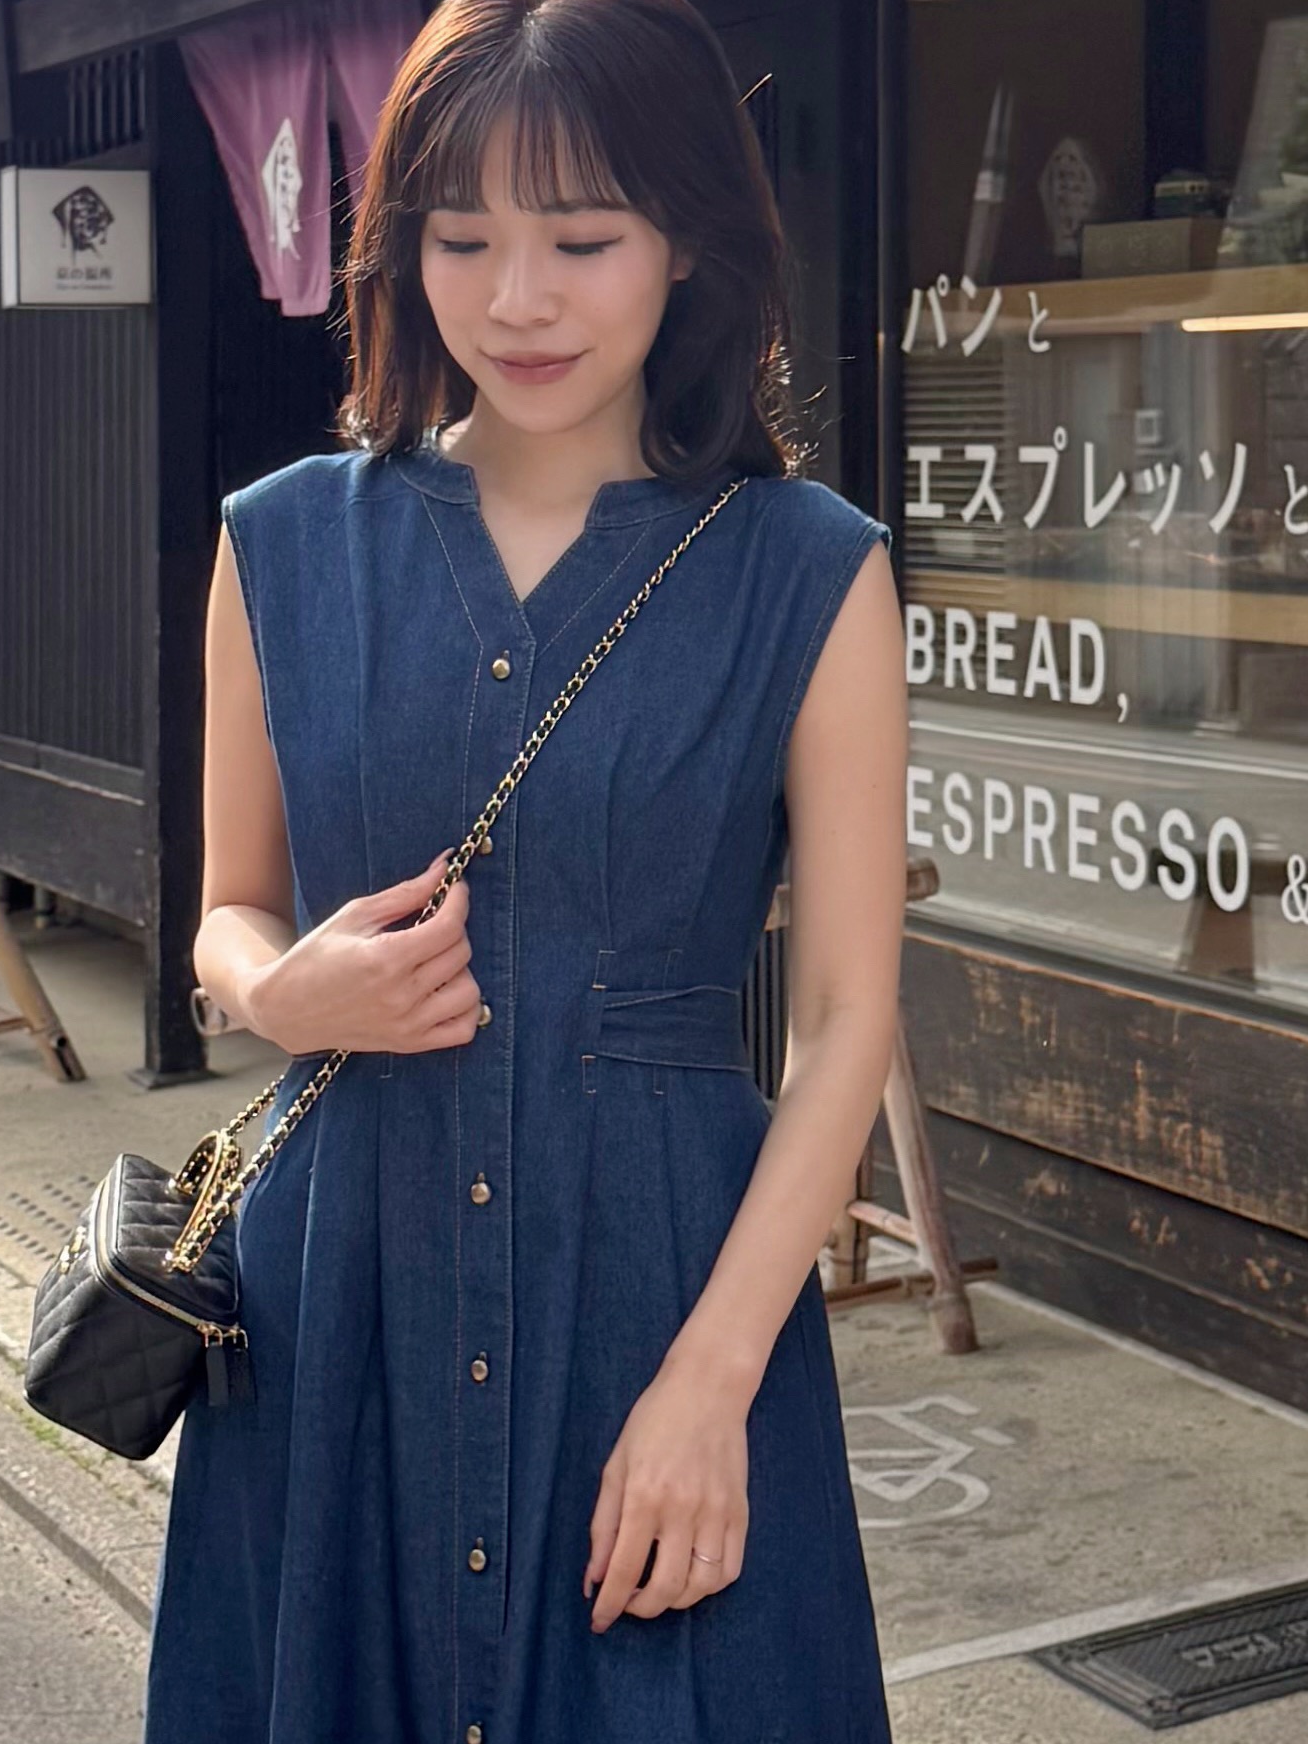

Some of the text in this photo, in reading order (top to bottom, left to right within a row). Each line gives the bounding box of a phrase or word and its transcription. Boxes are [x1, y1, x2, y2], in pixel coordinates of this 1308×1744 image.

[900, 273, 1051, 357] パンと
[905, 604, 1131, 723] BREAD,
[906, 764, 1251, 913] ESPRESSO
